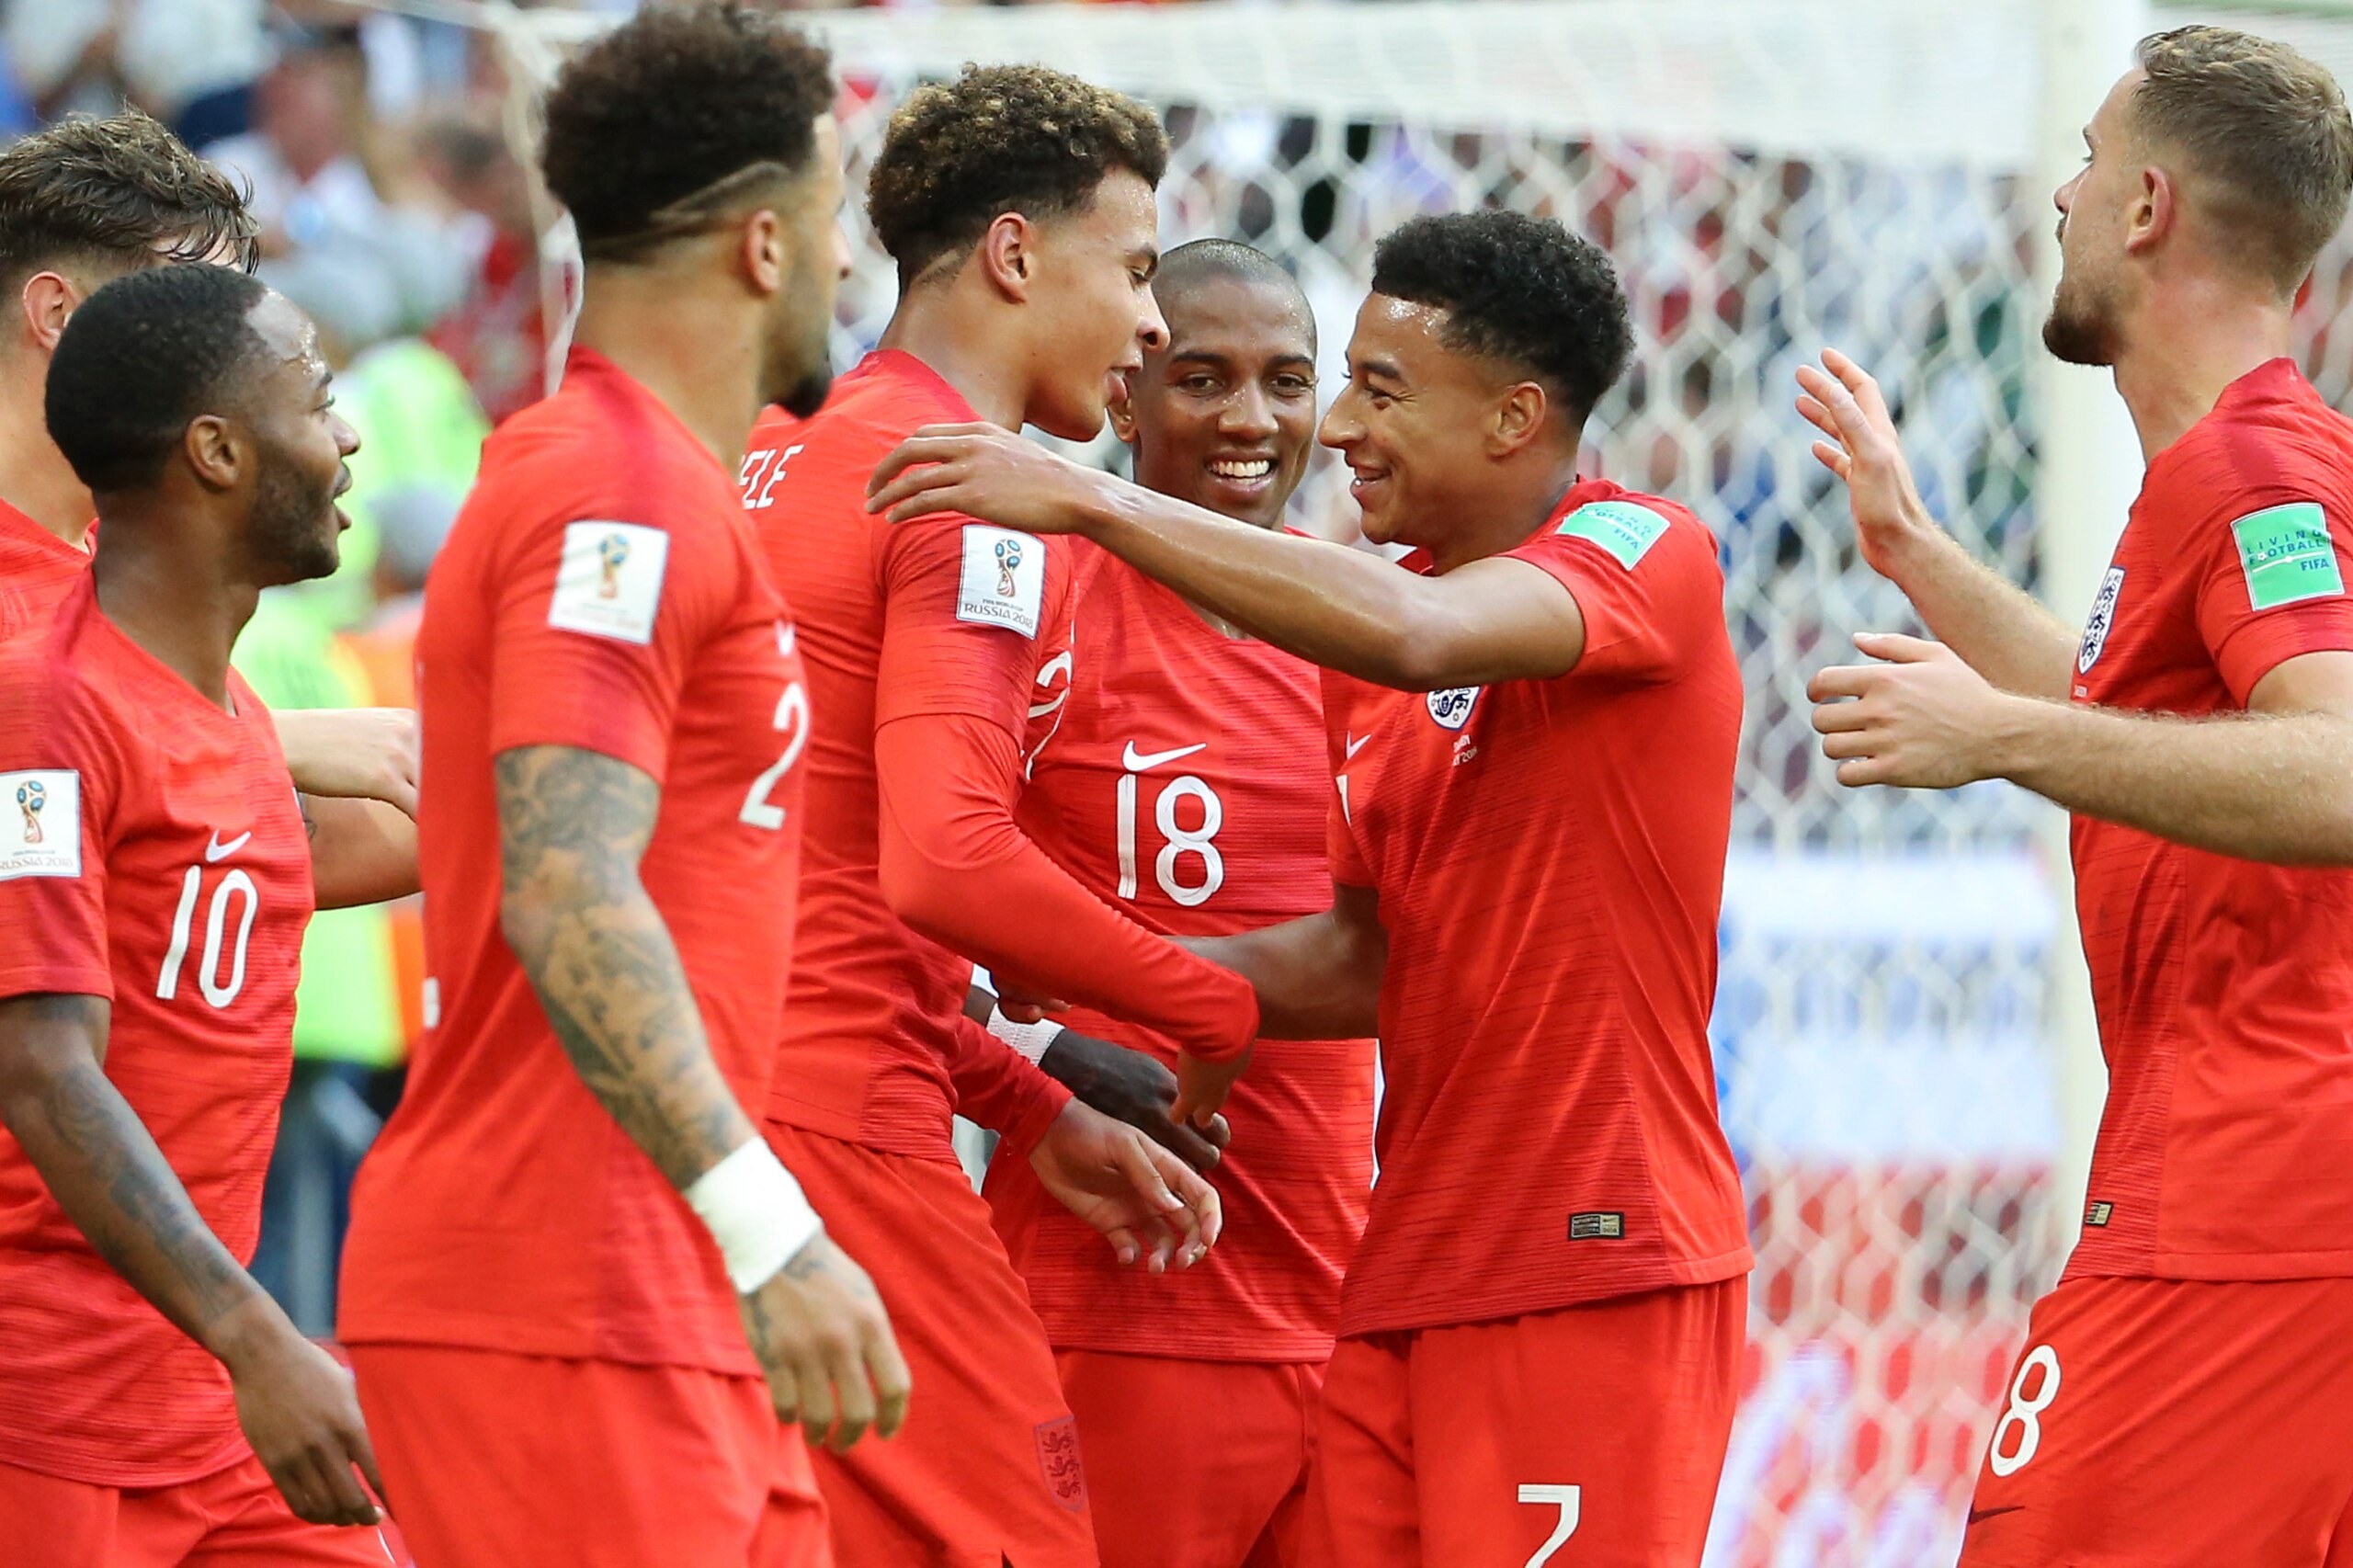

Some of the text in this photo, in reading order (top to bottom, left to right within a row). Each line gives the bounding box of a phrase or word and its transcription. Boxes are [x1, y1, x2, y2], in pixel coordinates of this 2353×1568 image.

[738, 444, 805, 510] ELE
[2246, 529, 2323, 554] LIVING
[2300, 558, 2330, 572] FIFA
[963, 603, 1011, 619] RUSSIA
[738, 682, 811, 831] 2
[1116, 772, 1224, 907] 18
[155, 864, 259, 1009] 10
[1990, 1344, 2063, 1478] 8
[1518, 1483, 1581, 1568] 7
